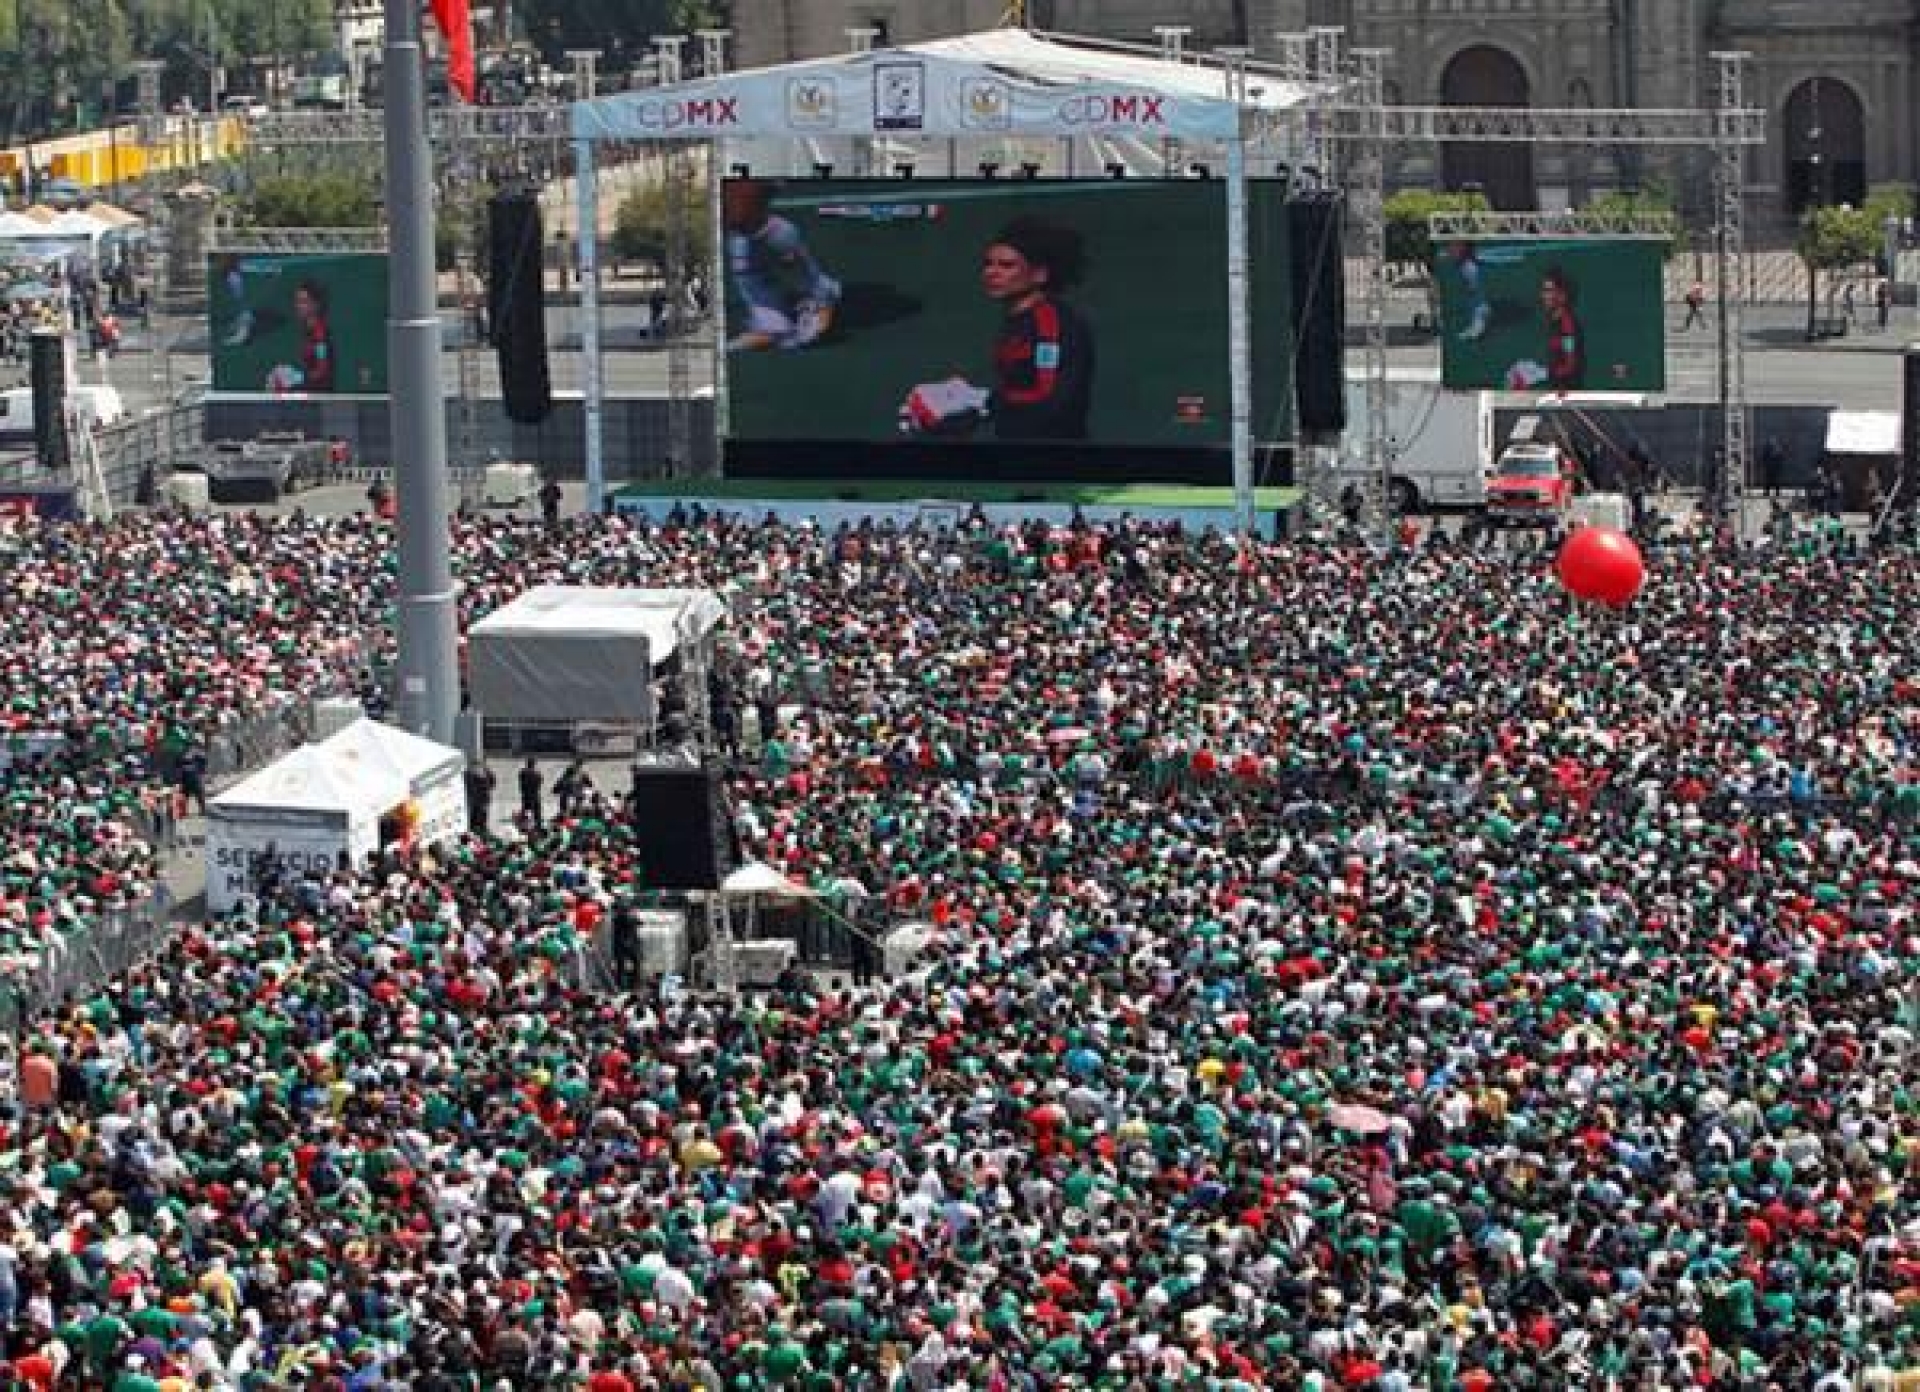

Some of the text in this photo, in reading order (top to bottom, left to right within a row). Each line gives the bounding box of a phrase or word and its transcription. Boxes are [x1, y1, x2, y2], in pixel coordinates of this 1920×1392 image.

[637, 97, 737, 128] CDMX
[1059, 96, 1162, 125] CDMX
[216, 848, 334, 872] SERCIO
